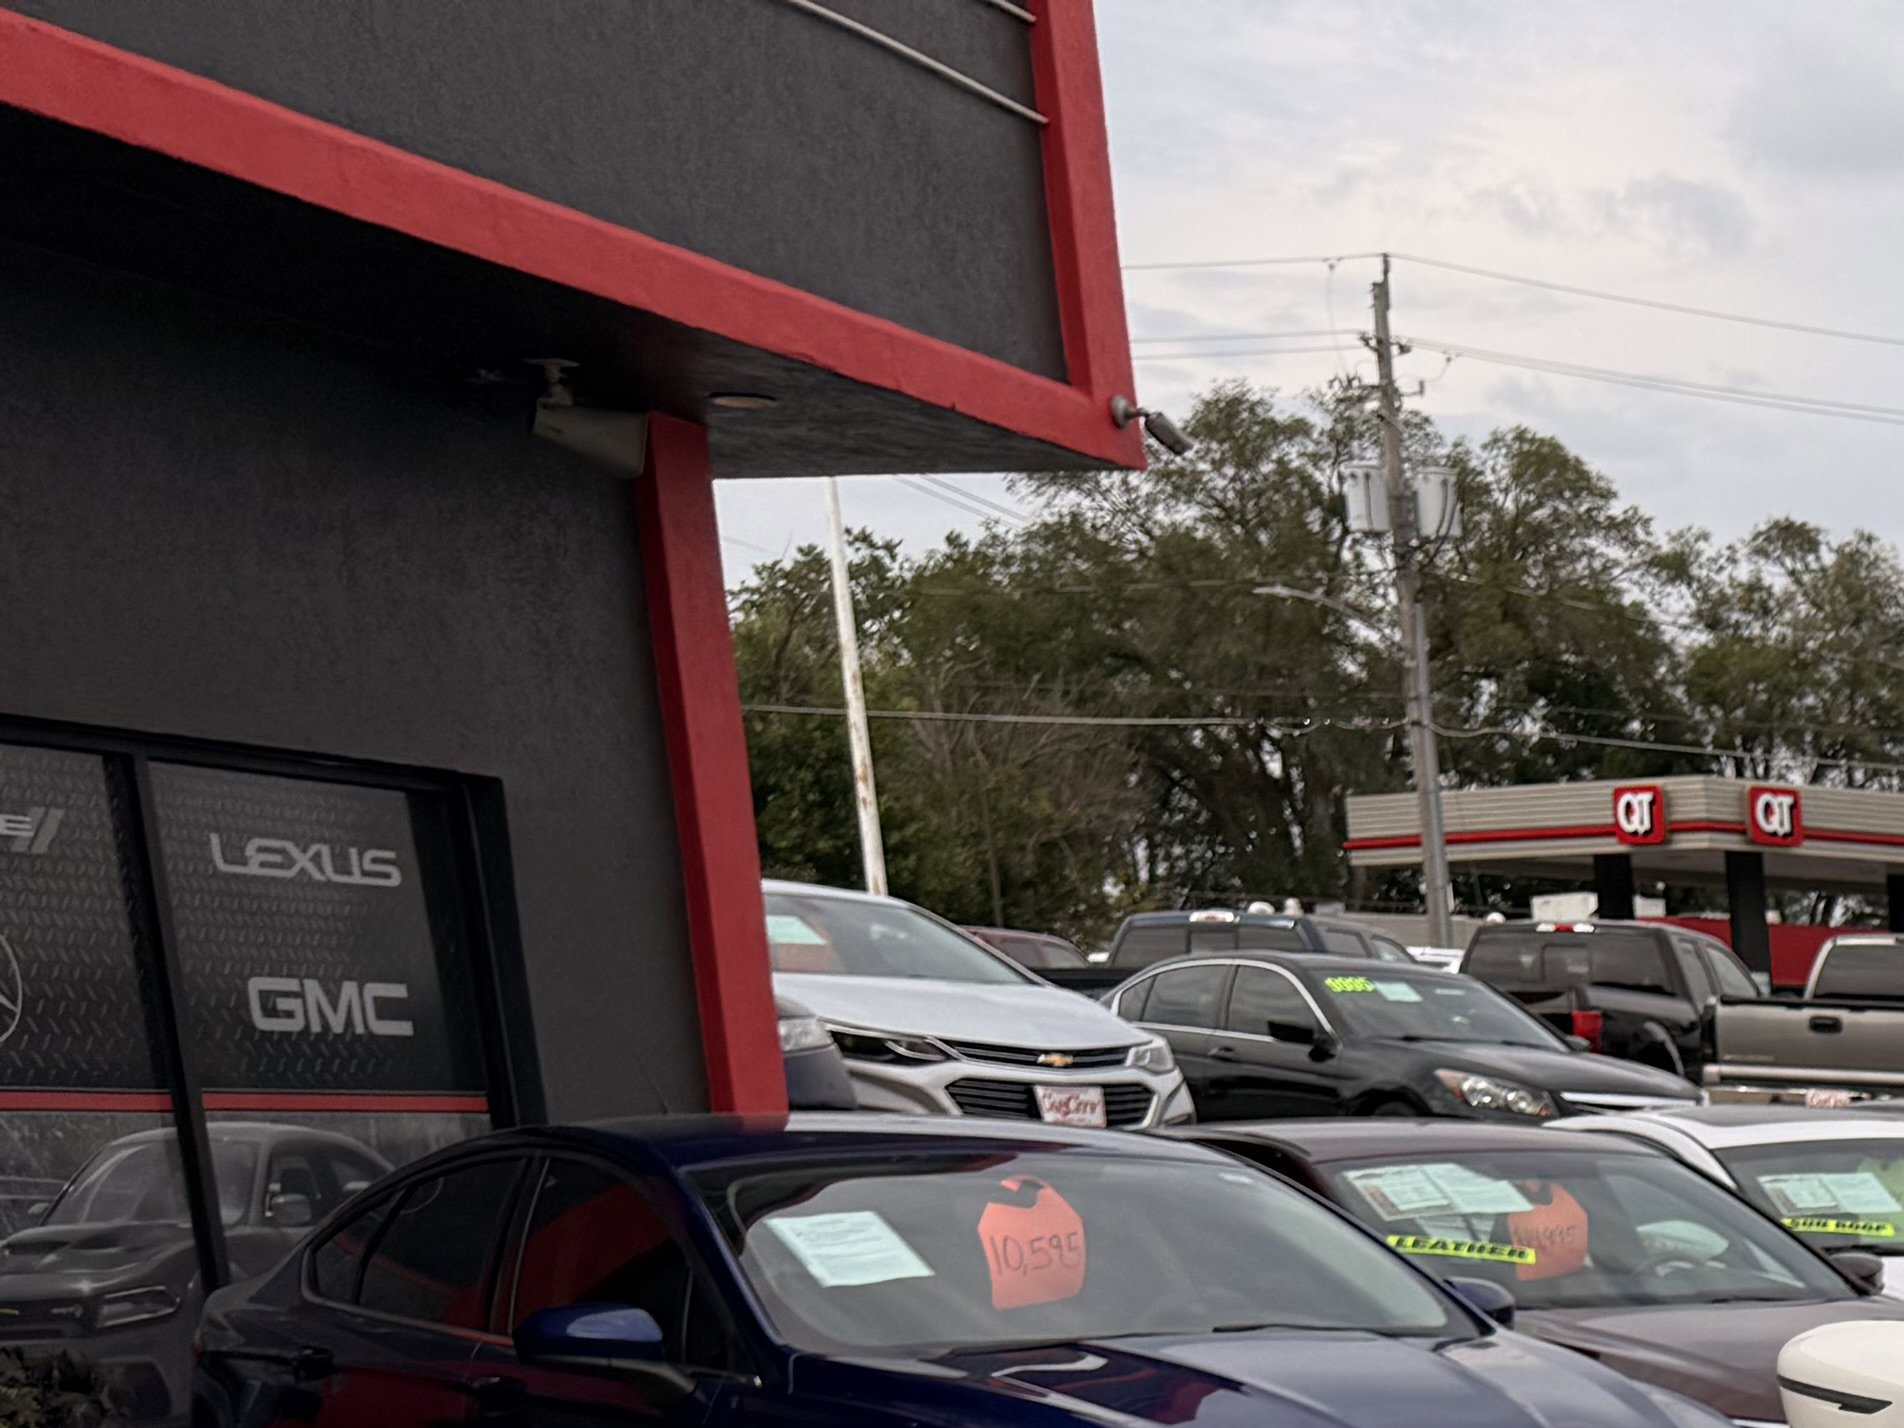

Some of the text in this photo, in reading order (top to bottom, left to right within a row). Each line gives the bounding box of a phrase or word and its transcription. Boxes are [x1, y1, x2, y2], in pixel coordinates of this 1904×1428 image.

[1617, 792, 1654, 836] QT
[1755, 793, 1794, 837] QT
[209, 832, 401, 887] LEXUS
[247, 976, 414, 1036] GMC
[989, 1231, 1081, 1276] 10,595
[1395, 1236, 1527, 1258] LEATHER
